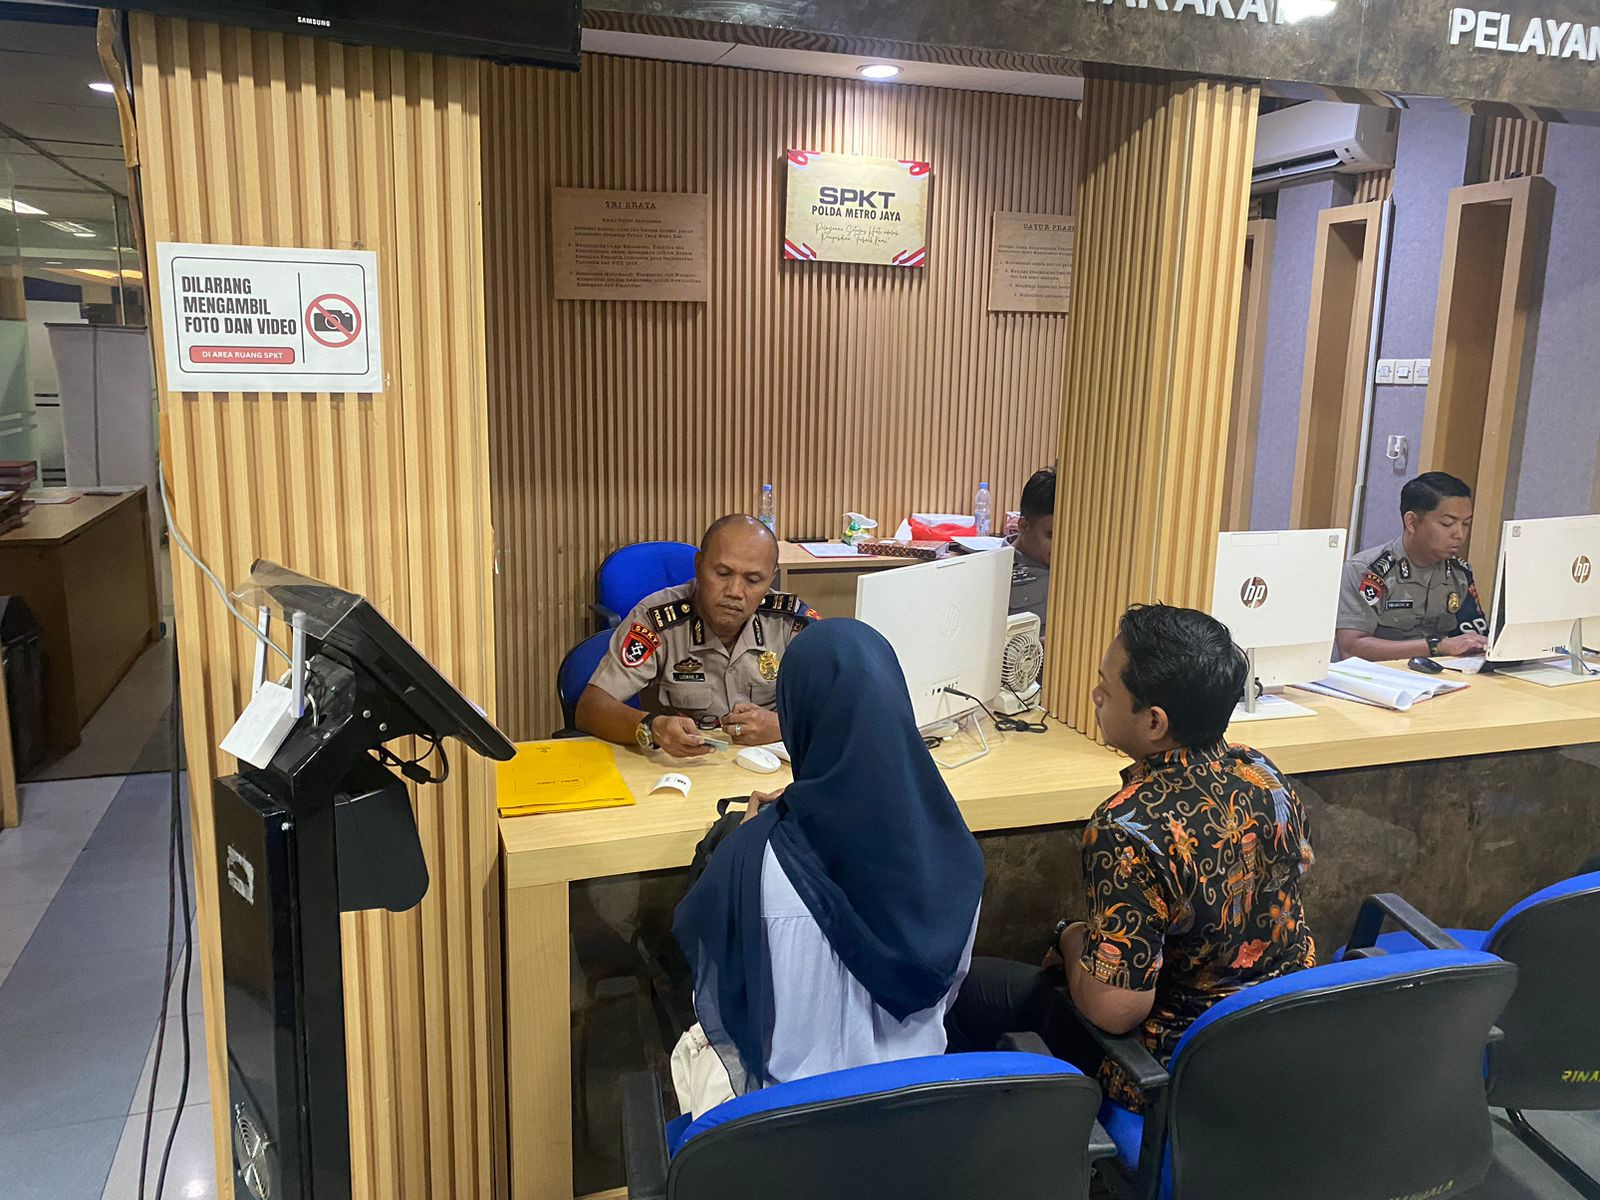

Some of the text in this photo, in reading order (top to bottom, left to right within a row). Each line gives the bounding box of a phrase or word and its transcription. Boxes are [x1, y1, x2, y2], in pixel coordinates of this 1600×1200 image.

[297, 16, 331, 27] SAMSUNG
[624, 201, 657, 210] BRATA
[819, 186, 896, 209] SPKT
[811, 205, 901, 222] POLDA METRO JAYA
[181, 276, 252, 295] DILARANG
[183, 296, 271, 315] MENGAMBIL
[184, 316, 297, 335] FOTO DAN VIDEO
[234, 351, 262, 359] RUANG
[1242, 576, 1267, 609] hp
